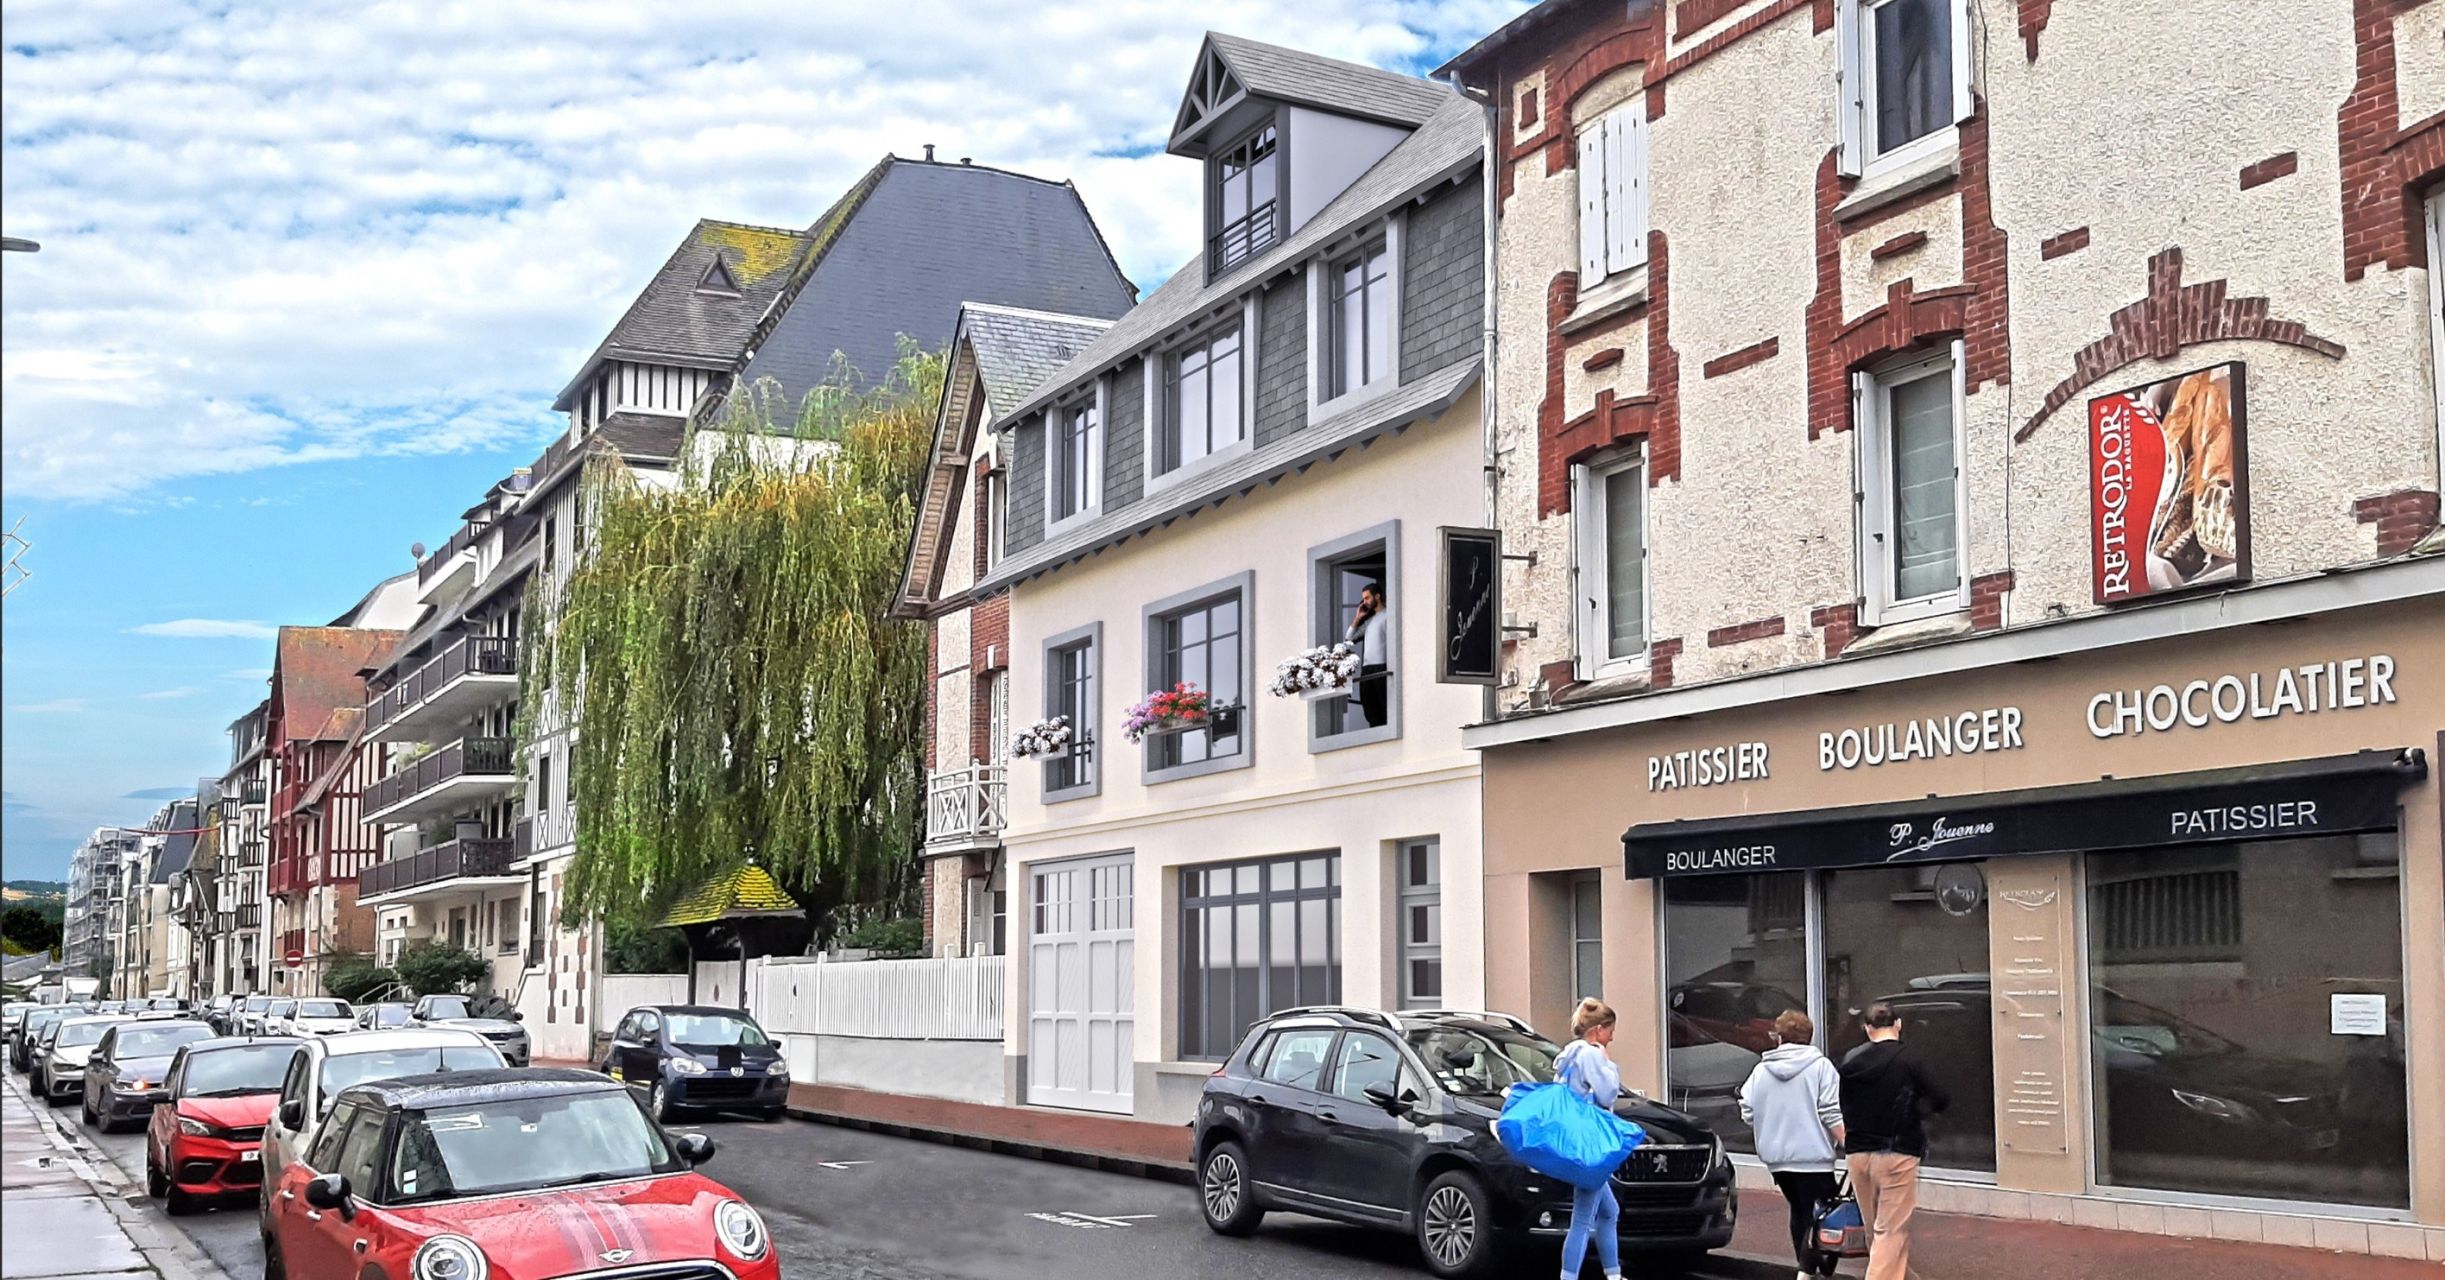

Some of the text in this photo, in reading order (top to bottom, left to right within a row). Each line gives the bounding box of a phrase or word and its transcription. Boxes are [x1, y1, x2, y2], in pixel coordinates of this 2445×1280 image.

[2101, 404, 2130, 597] RETRODOR
[2122, 409, 2133, 490] LA BAGUETTE
[1648, 654, 2396, 791] PATISSIER BOULANGER CHOCOLATIER
[1667, 845, 1776, 871] BOULANGER
[1918, 816, 1995, 851] Jouenne
[2171, 800, 2318, 834] PATISSIER
